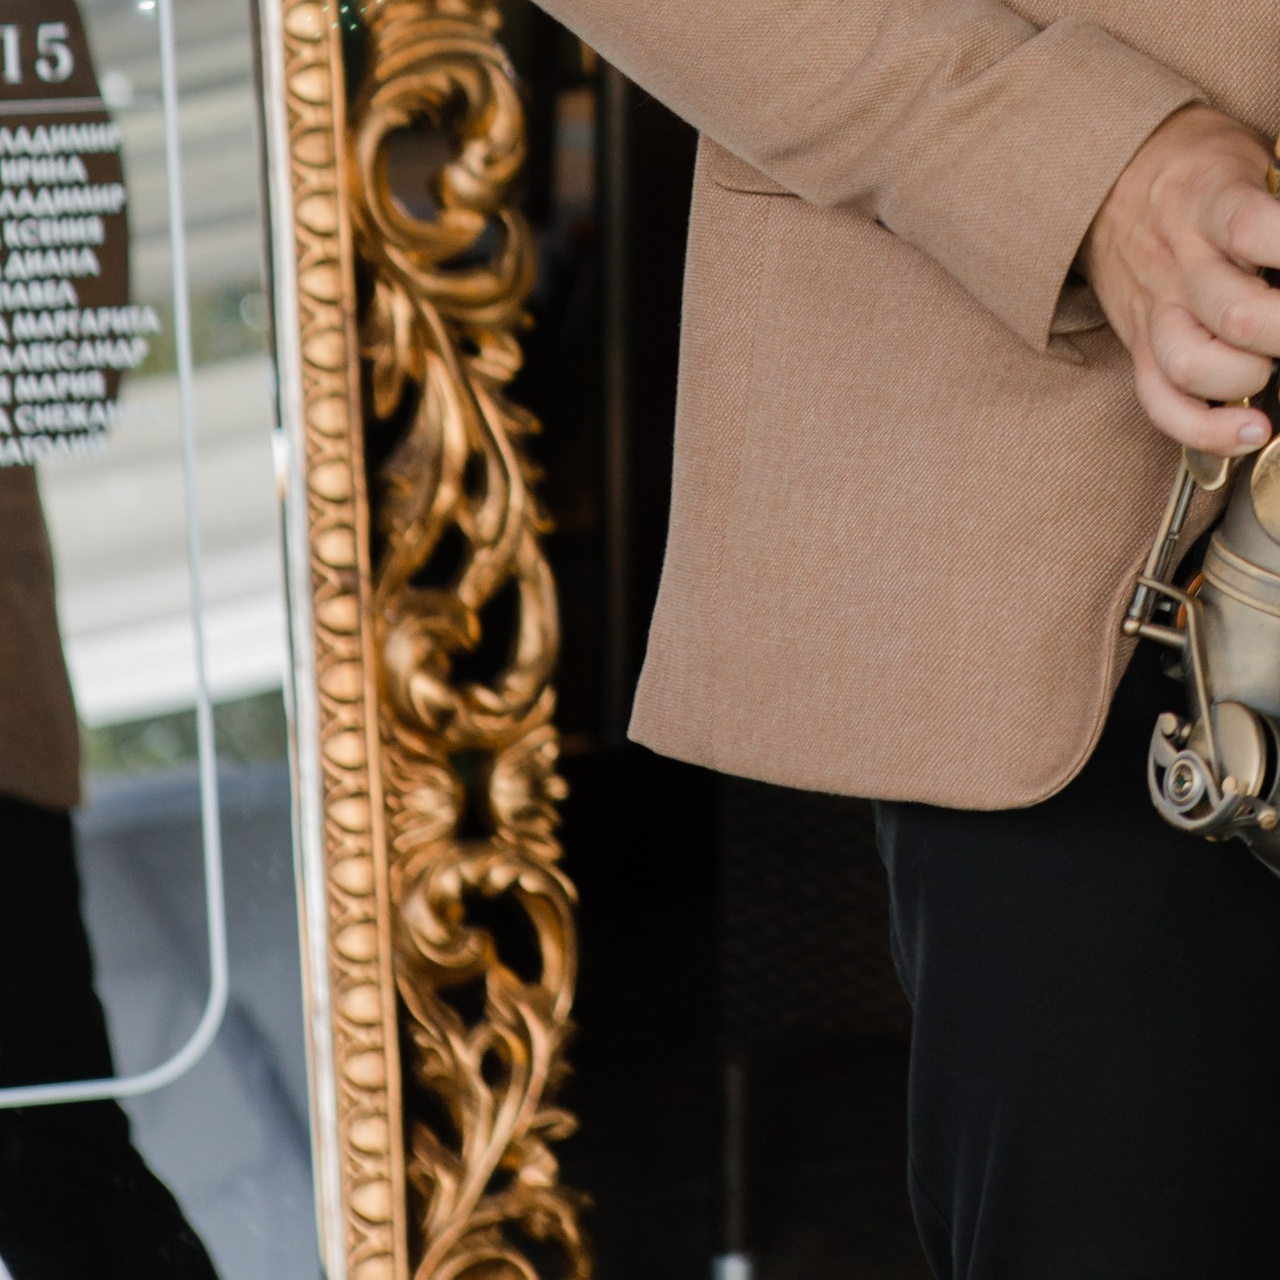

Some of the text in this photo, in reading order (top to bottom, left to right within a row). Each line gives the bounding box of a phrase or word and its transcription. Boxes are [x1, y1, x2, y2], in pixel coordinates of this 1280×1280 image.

[2, 22, 74, 83] 15
[12, 305, 160, 340] МАРГАРИТА
[14, 369, 106, 403] МАРИЯ
